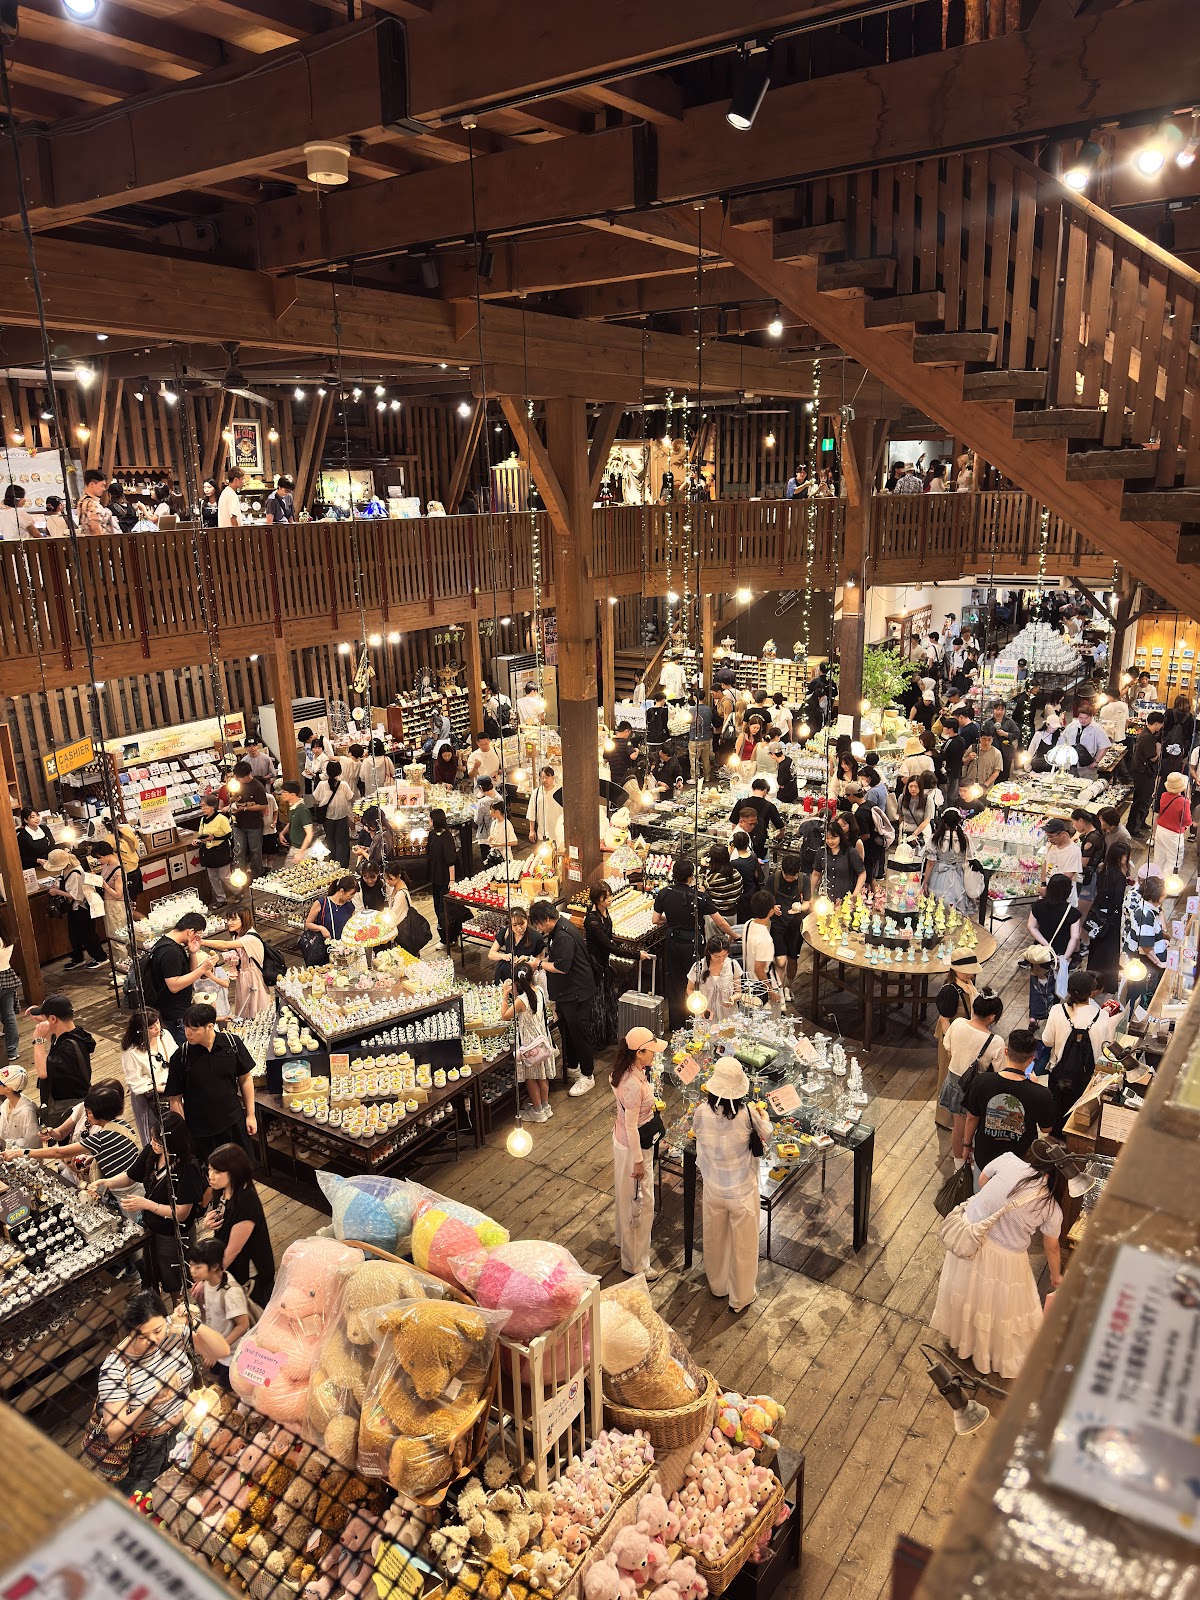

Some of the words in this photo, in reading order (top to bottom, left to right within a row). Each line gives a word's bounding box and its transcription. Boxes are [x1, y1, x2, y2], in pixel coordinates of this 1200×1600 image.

[58, 743, 90, 764] CASHIER
[144, 788, 163, 800] お会計
[142, 797, 168, 809] CASHIER
[984, 1127, 1022, 1142] HURLEY
